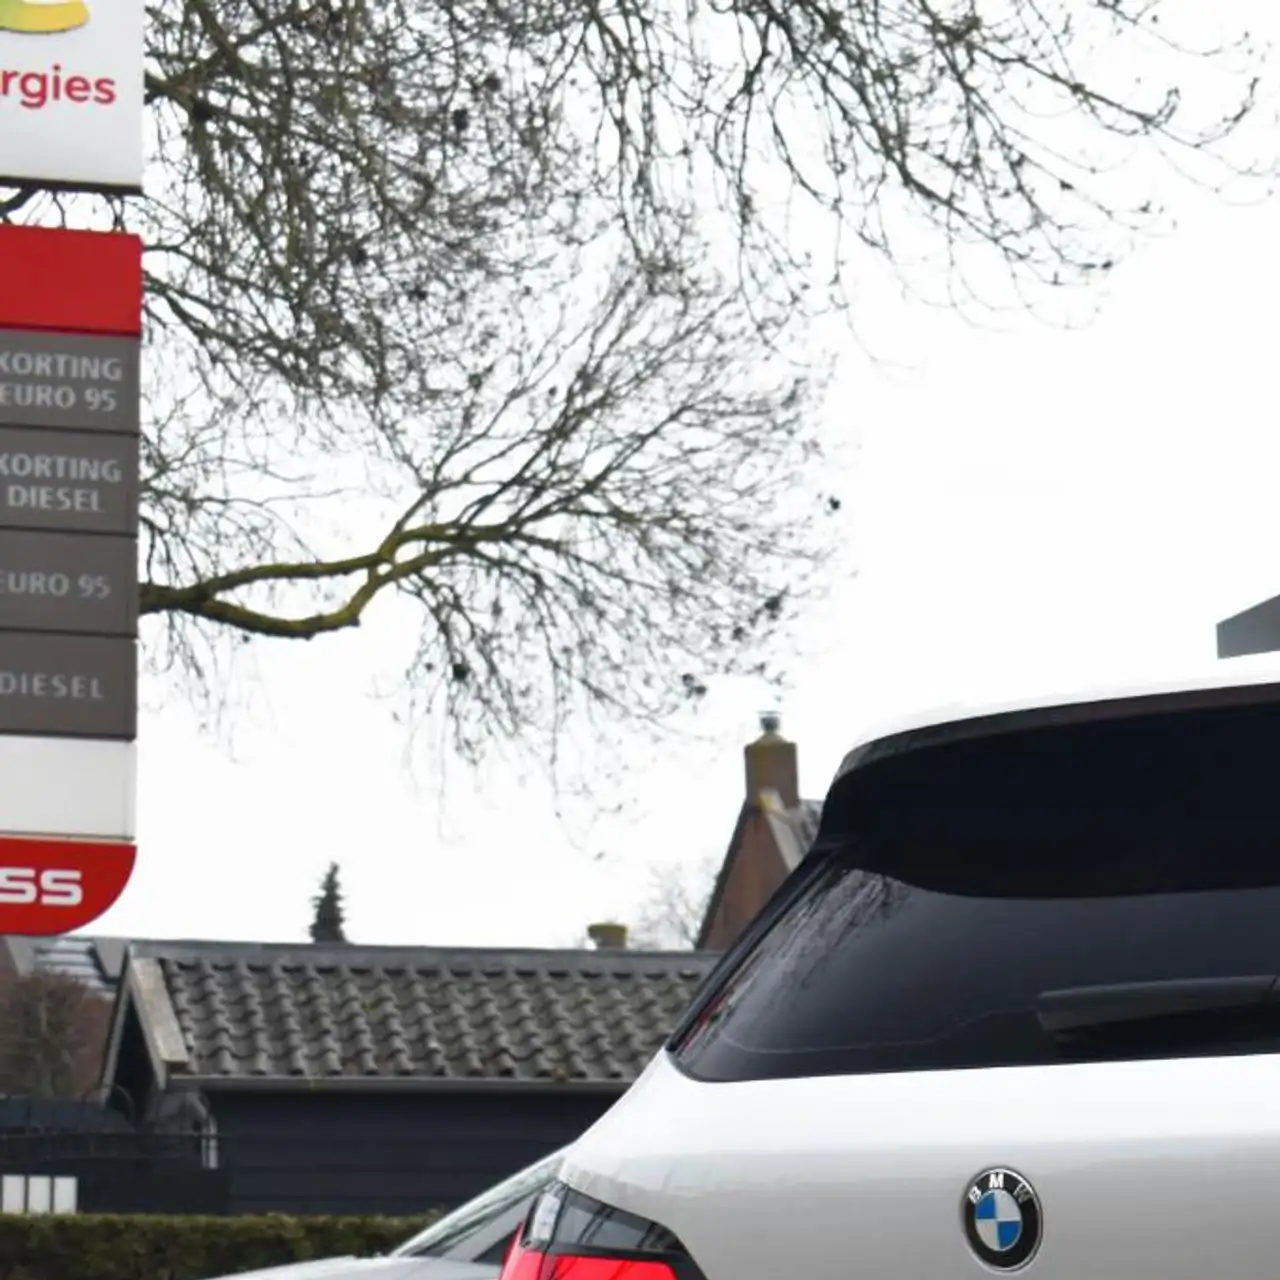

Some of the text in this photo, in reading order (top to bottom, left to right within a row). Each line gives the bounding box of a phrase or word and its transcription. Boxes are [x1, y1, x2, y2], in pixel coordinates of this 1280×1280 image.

[0, 382, 117, 412] EURO 95
[7, 484, 105, 513] DIESEL
[78, 573, 111, 600] 95
[0, 671, 103, 699] DIESEL
[968, 1172, 1035, 1205] BMW
